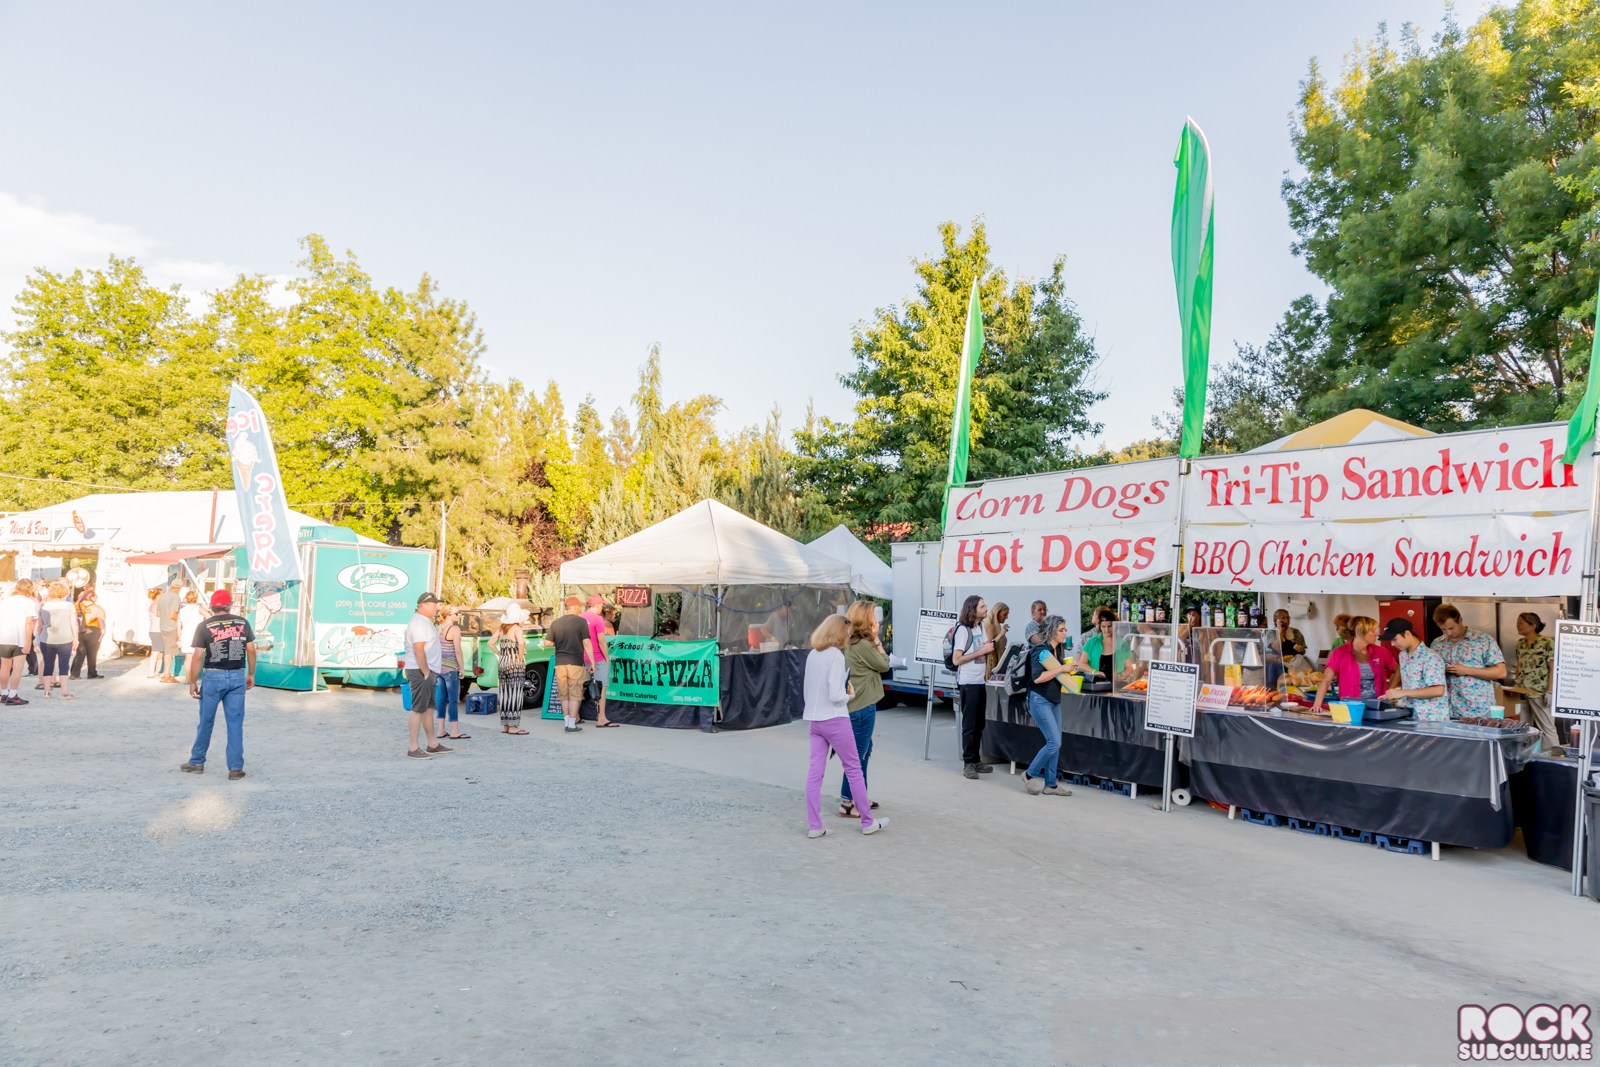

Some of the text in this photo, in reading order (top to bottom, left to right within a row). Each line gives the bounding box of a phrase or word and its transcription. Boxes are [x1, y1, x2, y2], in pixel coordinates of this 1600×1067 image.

[1201, 438, 1579, 519] Tri-Tip Sandwich
[956, 476, 1170, 521] Corn Dogs
[10, 520, 49, 536] Wine & Beer
[955, 534, 1157, 584] Hot Dogs
[1191, 531, 1572, 586] BBQ Chicken Sandwich
[350, 566, 399, 586] Cruisers
[617, 589, 648, 604] PIZZA
[335, 600, 352, 608] (209)
[926, 610, 951, 619] MENU
[1571, 625, 1600, 635] ME
[618, 641, 645, 651] School
[647, 643, 662, 652] Pie
[613, 659, 713, 688] FIRE PIZZA
[1158, 663, 1189, 673] MENU
[634, 692, 658, 701] Catering
[1210, 688, 1228, 697] FRESH
[1198, 695, 1227, 705] LEMONADE
[1567, 708, 1596, 716] THANK
